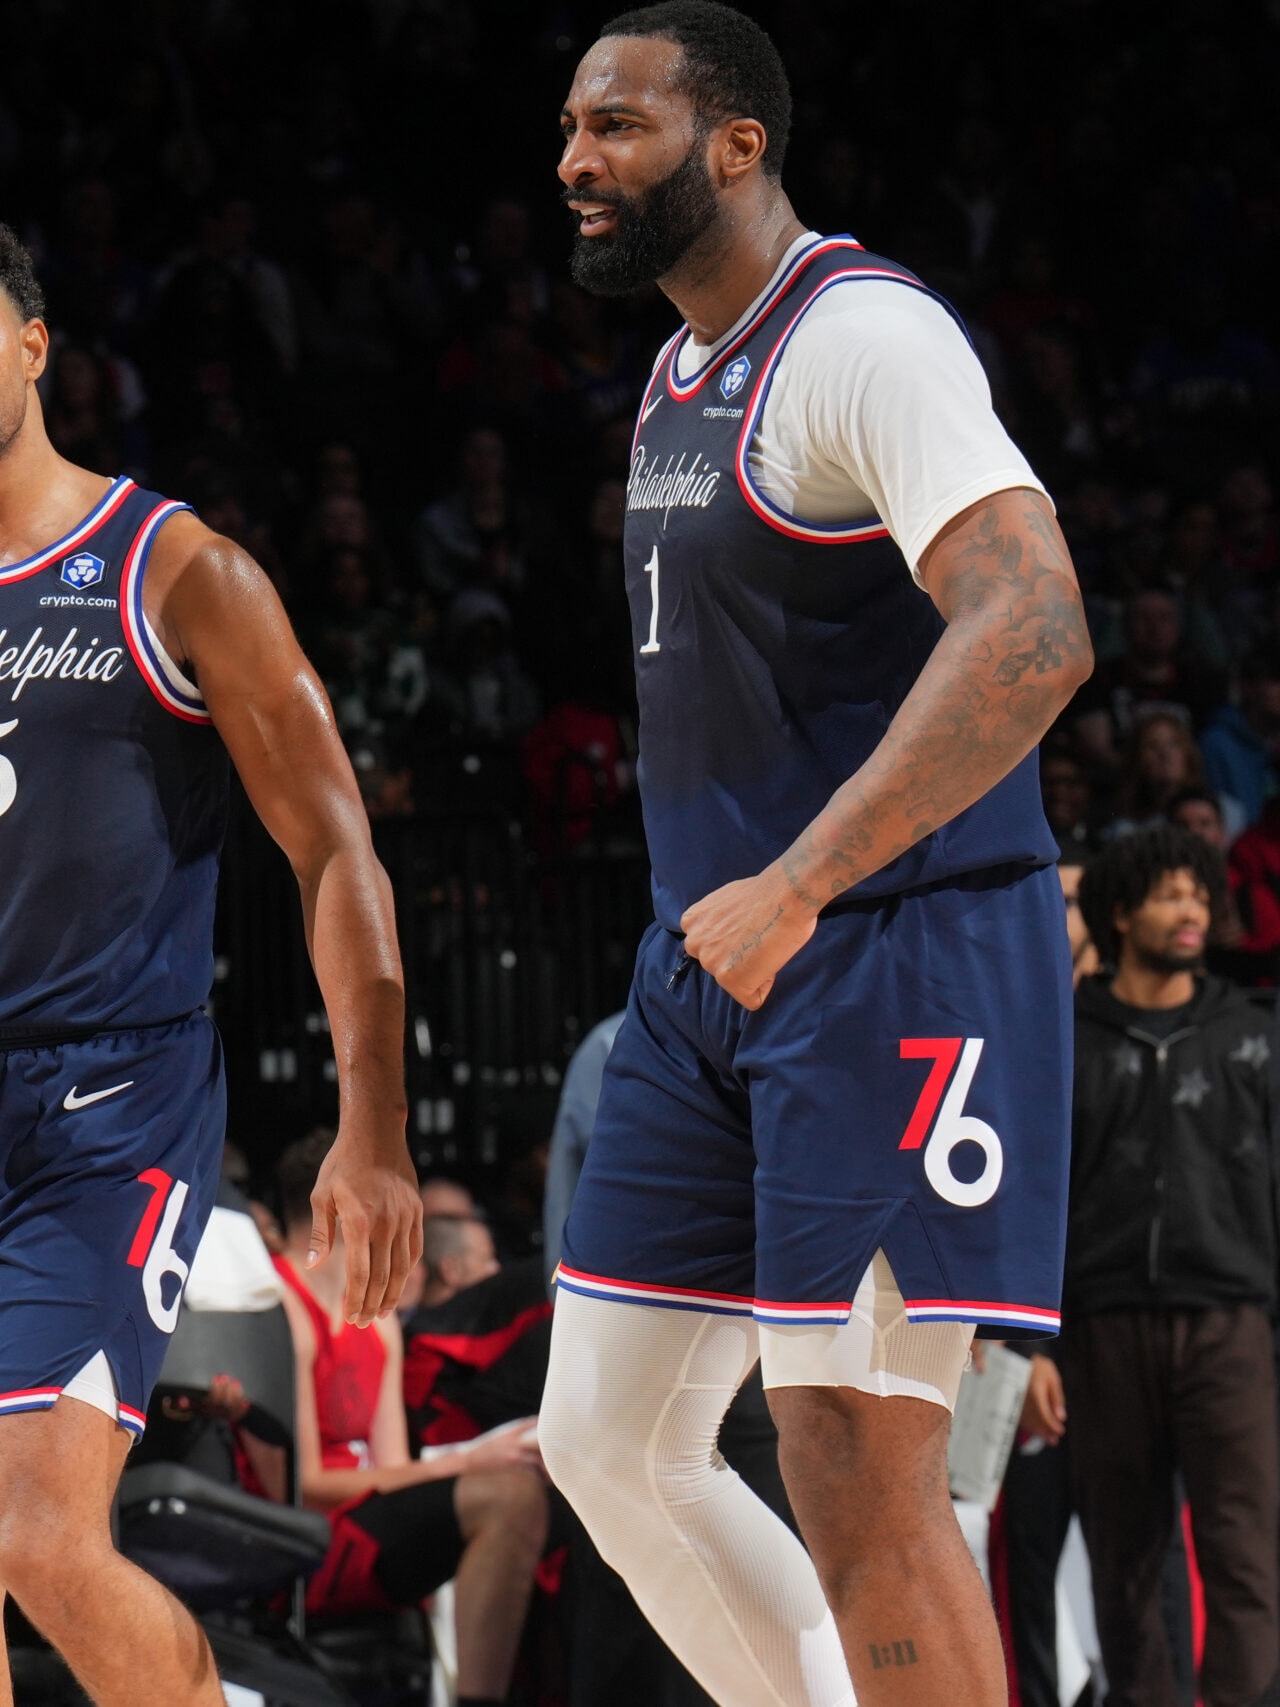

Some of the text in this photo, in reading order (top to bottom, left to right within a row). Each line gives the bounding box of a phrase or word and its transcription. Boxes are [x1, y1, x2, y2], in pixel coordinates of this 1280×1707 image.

[702, 406, 744, 419] crypto.com
[627, 445, 720, 531] Philadelphia
[39, 594, 117, 609] crypto.com
[640, 545, 661, 653] 1
[898, 1037, 1004, 1208] 76
